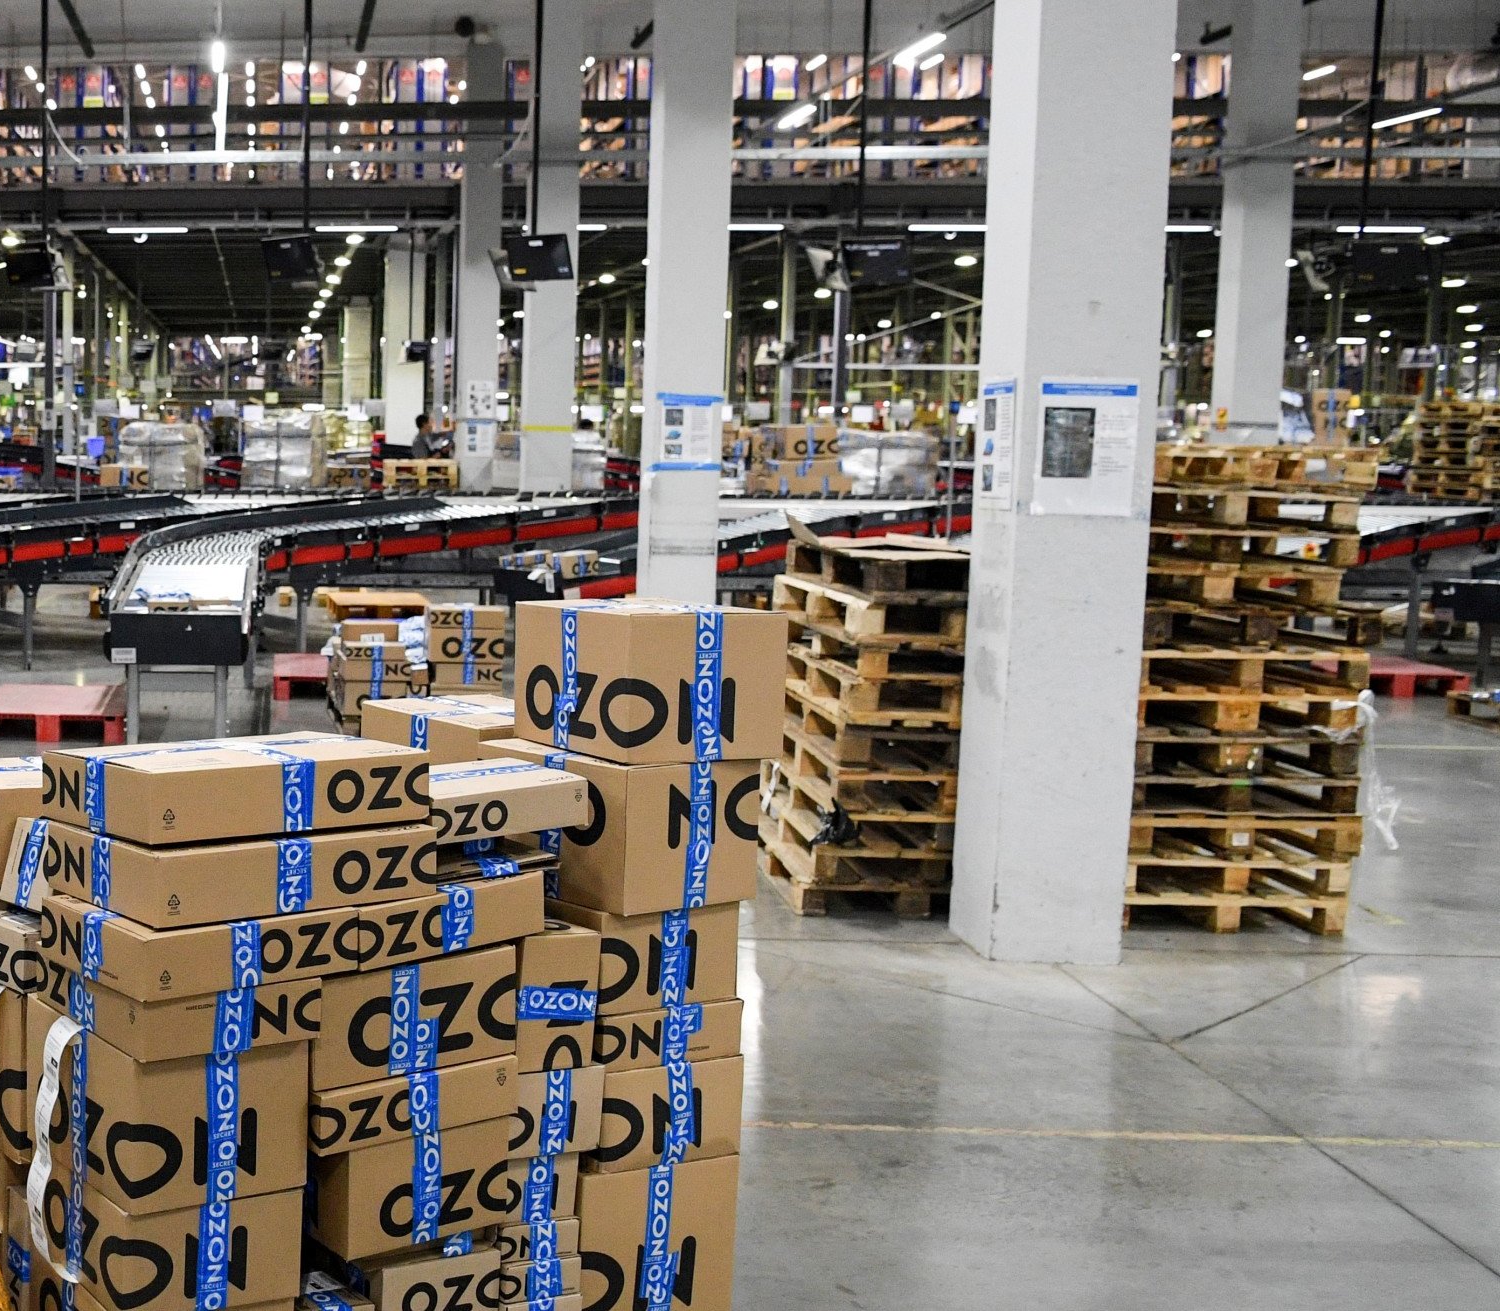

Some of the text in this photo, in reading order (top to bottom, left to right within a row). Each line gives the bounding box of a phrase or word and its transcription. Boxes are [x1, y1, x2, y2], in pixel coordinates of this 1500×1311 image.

[526, 664, 736, 748] OZON
[529, 989, 594, 1012] OZON
[213, 1131, 235, 1140] SECRET
[212, 1160, 235, 1169] SECRET
[651, 1180, 669, 1257] OZON
